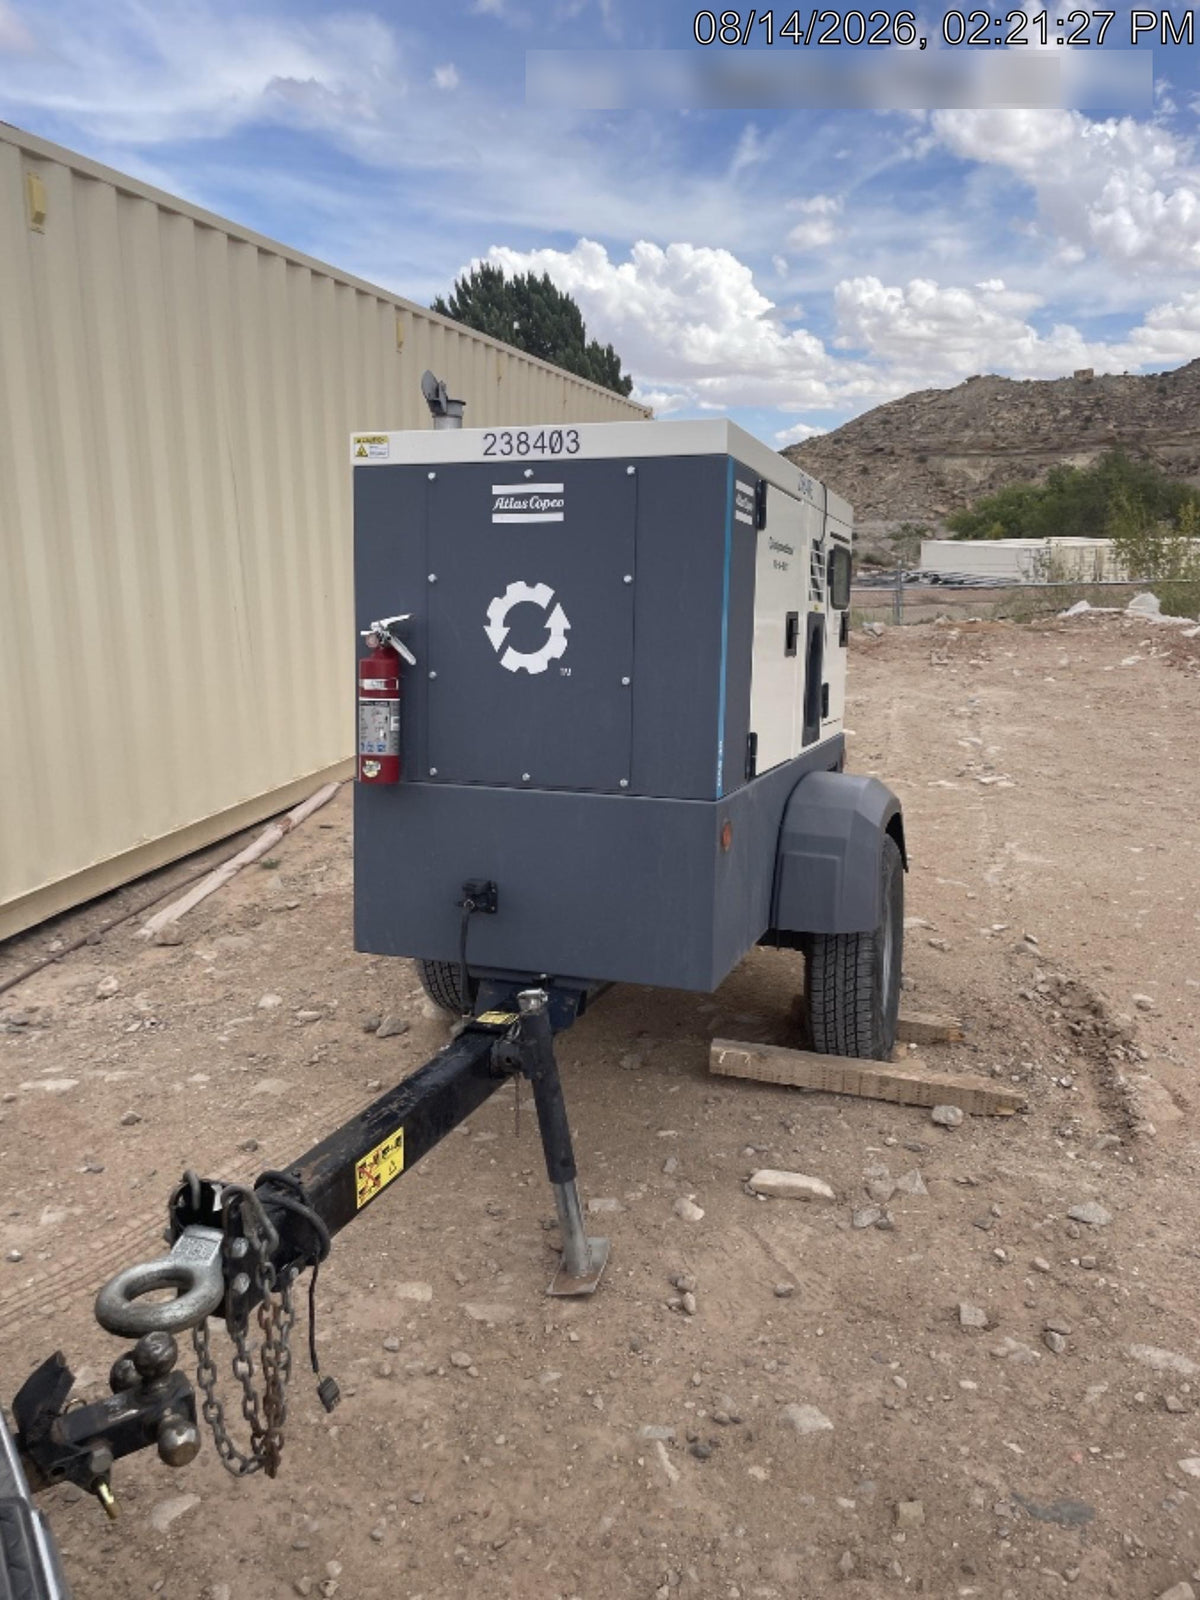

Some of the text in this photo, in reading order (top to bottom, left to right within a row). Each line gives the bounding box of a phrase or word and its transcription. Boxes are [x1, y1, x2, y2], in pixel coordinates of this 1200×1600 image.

[483, 429, 580, 456] 238403
[491, 495, 565, 511] Atlas Copco
